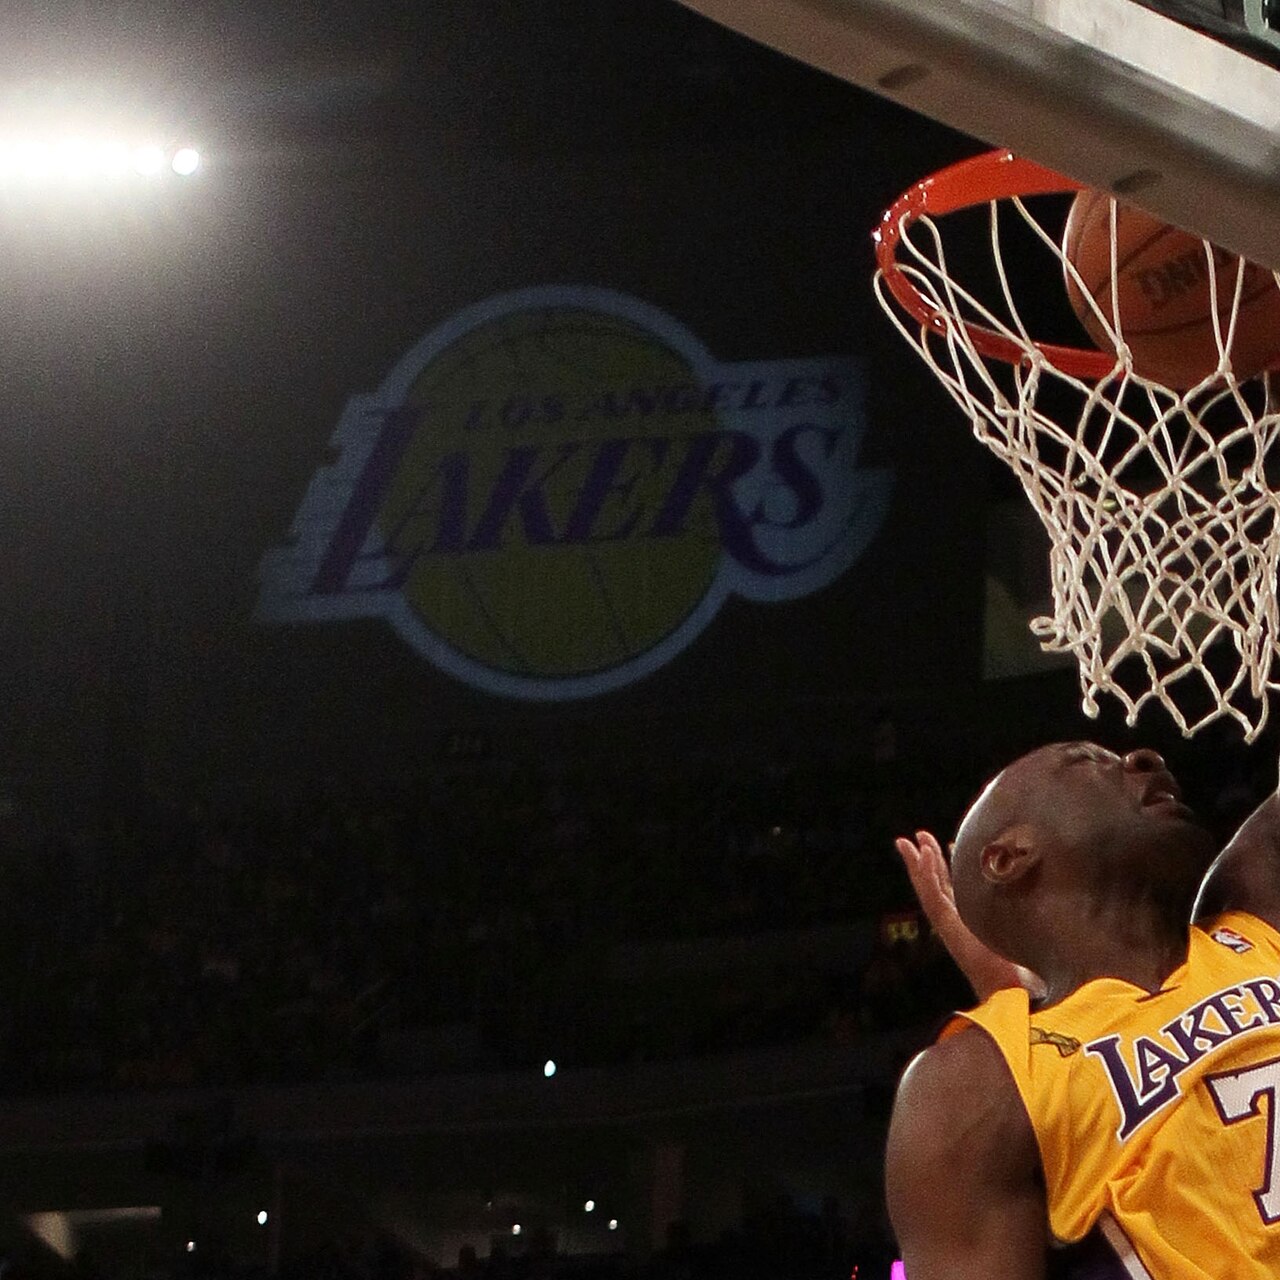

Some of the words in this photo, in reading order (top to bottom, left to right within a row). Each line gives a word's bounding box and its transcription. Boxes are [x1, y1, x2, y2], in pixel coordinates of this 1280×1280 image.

[464, 393, 563, 431] LOS
[580, 373, 844, 417] ANGELES
[308, 402, 848, 592] LAKERS
